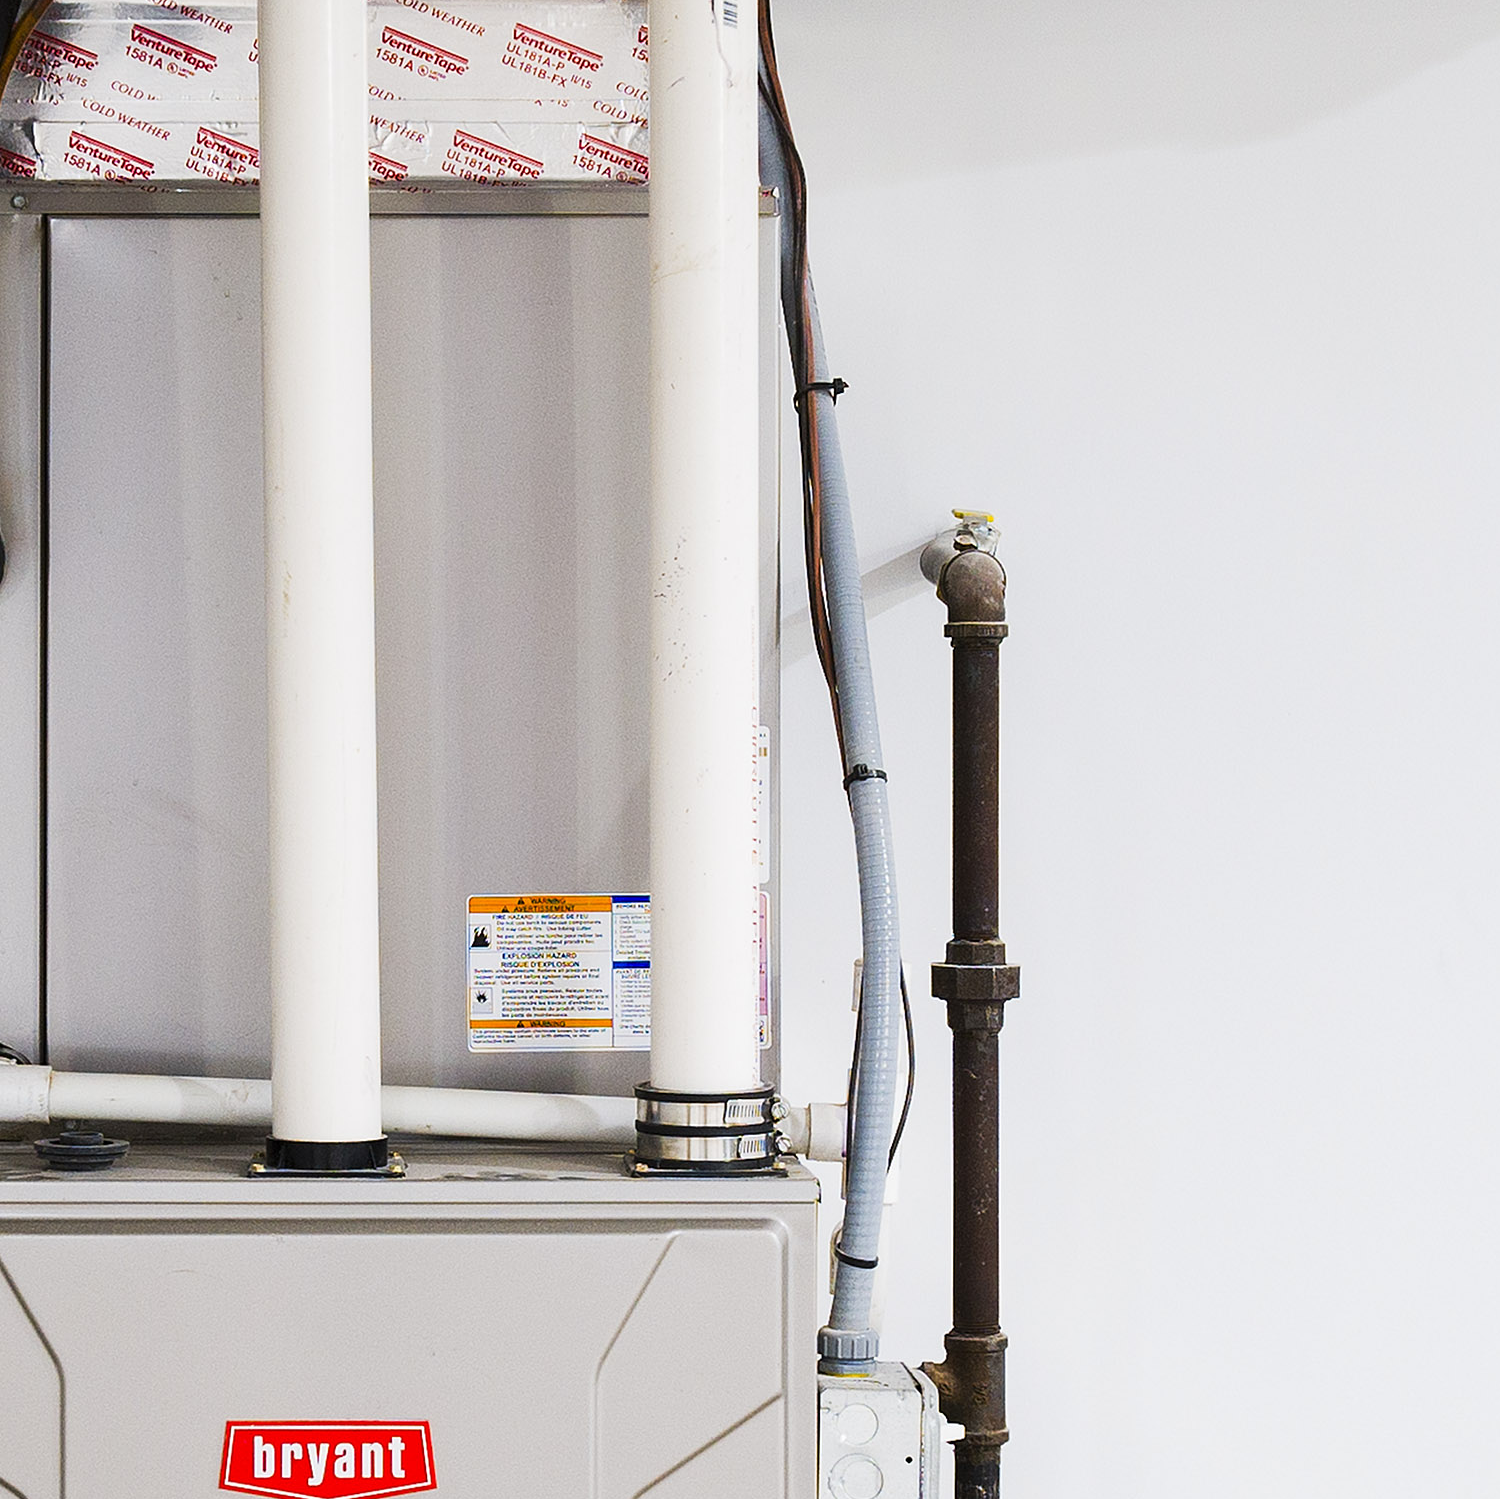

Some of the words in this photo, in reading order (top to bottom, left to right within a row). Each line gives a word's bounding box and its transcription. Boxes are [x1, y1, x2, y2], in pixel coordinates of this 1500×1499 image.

[431, 8, 486, 37] WEATHER
[131, 29, 218, 73] VentureTape
[375, 48, 413, 72] 1581A
[506, 42, 565, 70] UL181A-P
[82, 98, 115, 117] COLD
[118, 114, 171, 141] WEATHER
[63, 153, 101, 175] 1581A
[254, 1435, 405, 1486] bryant
